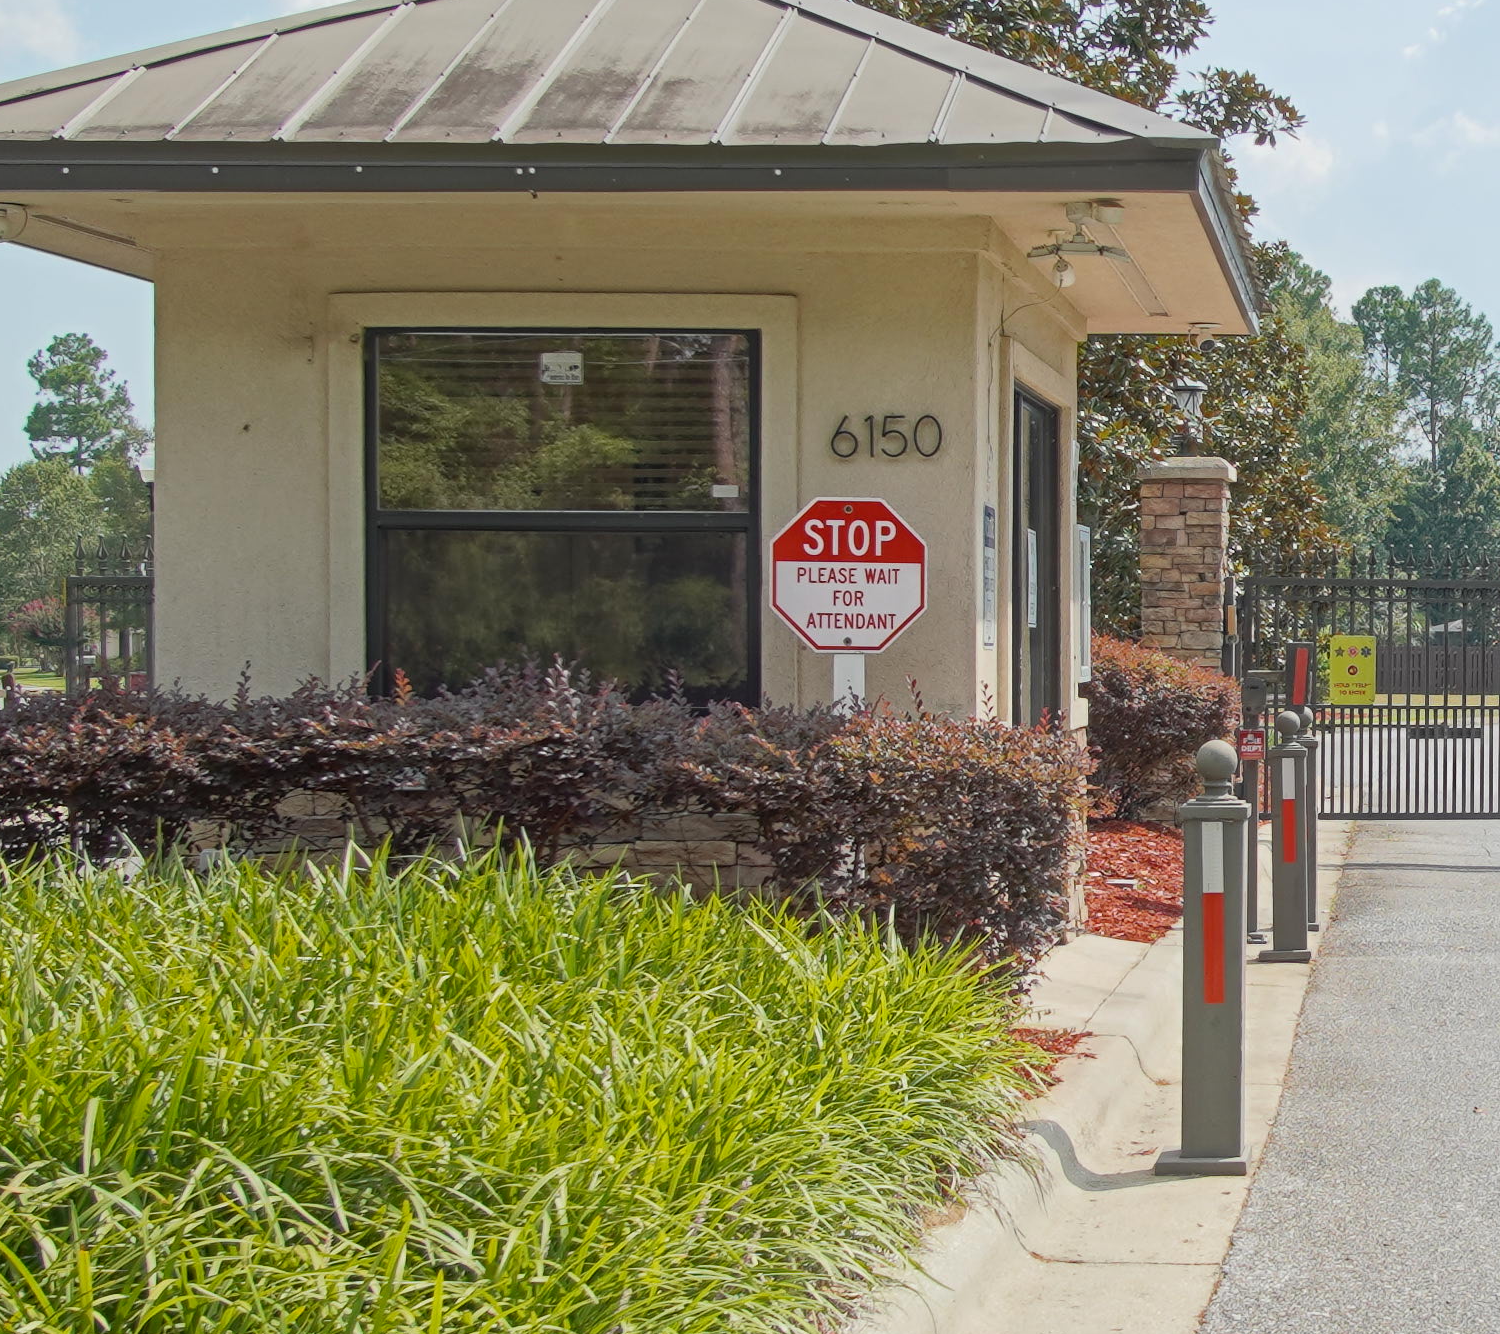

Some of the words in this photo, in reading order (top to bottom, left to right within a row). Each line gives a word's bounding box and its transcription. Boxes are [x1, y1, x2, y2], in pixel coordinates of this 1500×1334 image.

[831, 415, 942, 458] 6150
[802, 518, 897, 556] STOP
[797, 567, 857, 584] PLEASE
[865, 568, 900, 585] WAIT
[832, 590, 864, 606] FOR
[806, 612, 896, 630] ATTENDANT
